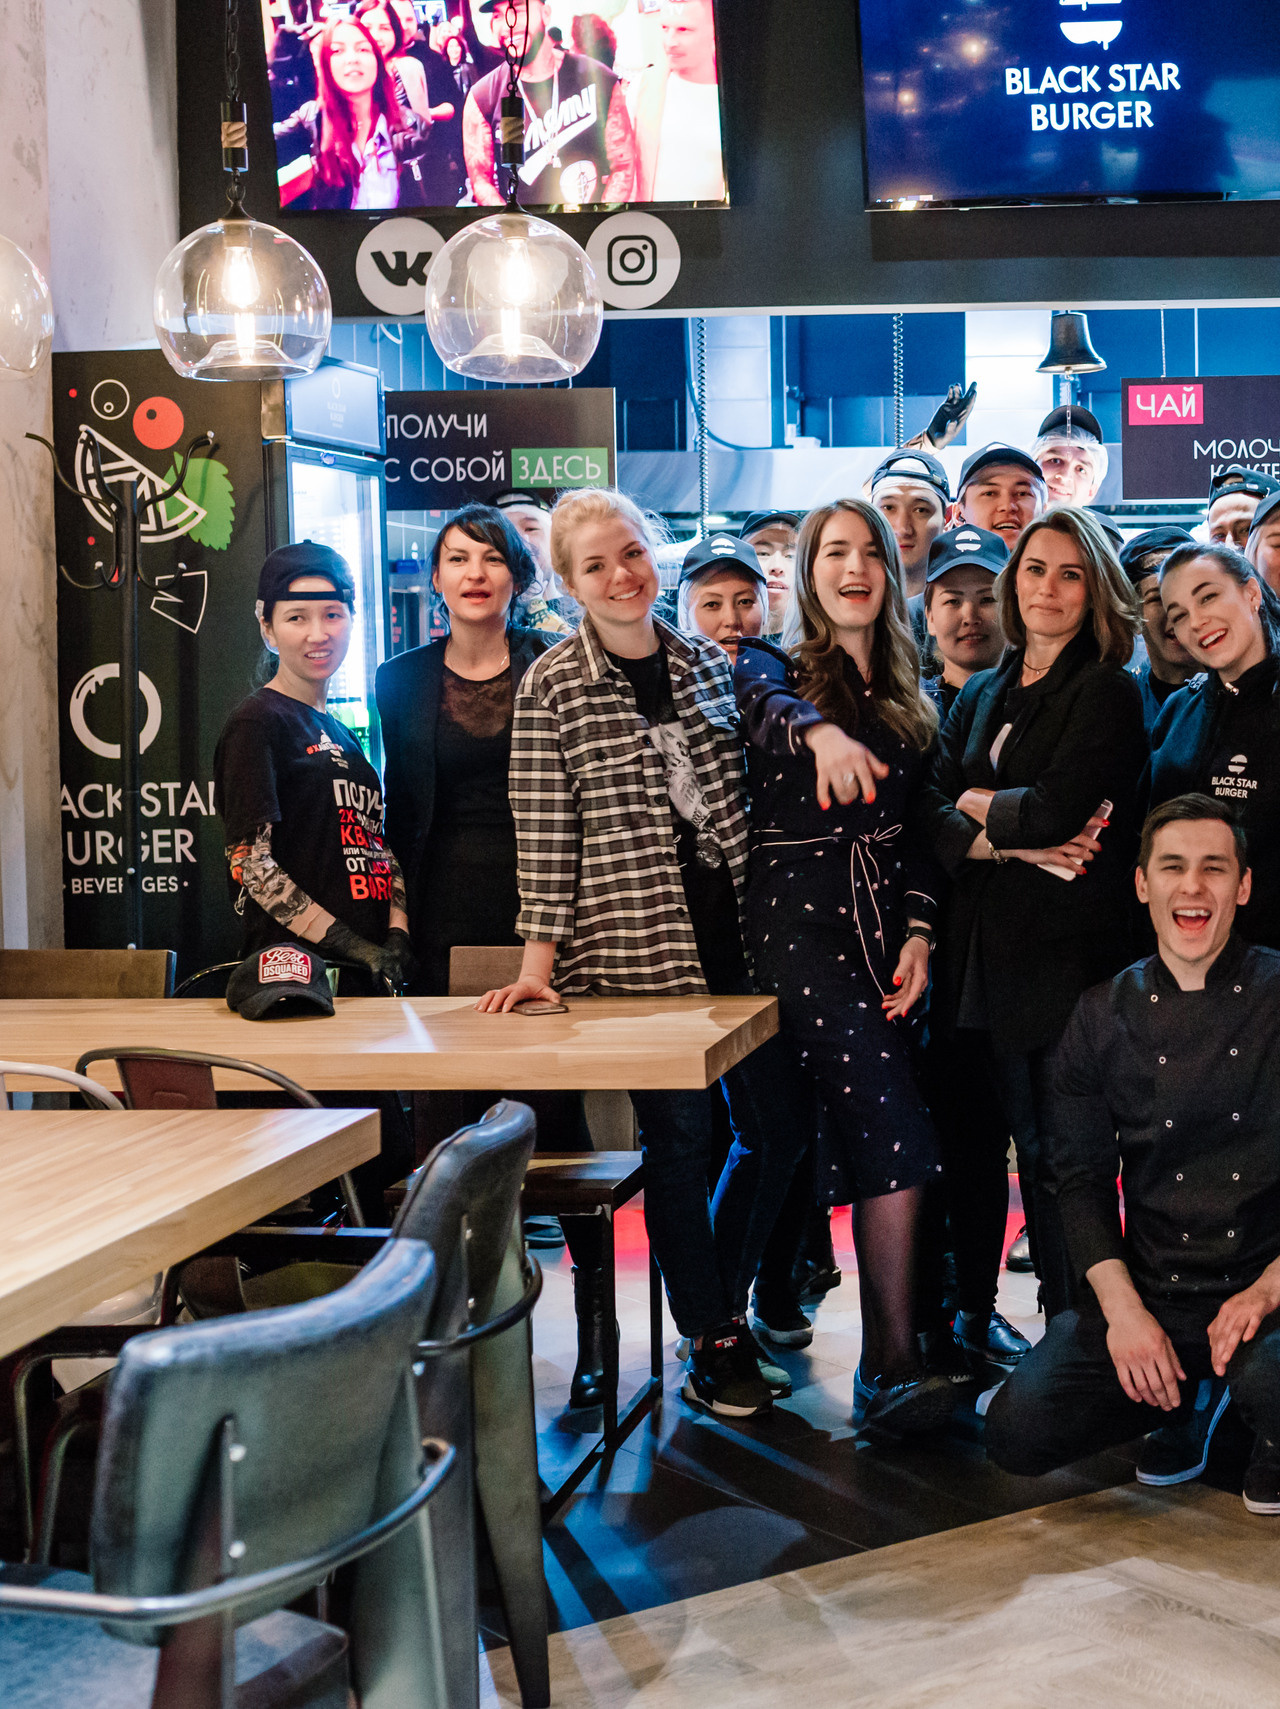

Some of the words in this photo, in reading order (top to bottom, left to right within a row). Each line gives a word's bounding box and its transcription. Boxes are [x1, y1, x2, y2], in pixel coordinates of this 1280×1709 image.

[1005, 65, 1102, 96] BLACK
[1108, 62, 1182, 93] STAR
[1030, 100, 1155, 132] BURGER
[1136, 386, 1196, 418] ЧАЙ
[386, 413, 487, 439] ПОЛУЧИ
[410, 450, 505, 482] СОБОЙ
[518, 455, 602, 485] ЗДЕСЬ
[1211, 776, 1236, 786] BLACK
[1236, 778, 1258, 790] STAR
[1215, 787, 1248, 799] BURGER
[345, 857, 366, 872] ОТ
[266, 950, 305, 966] Best
[263, 963, 308, 977] DSQUARED
